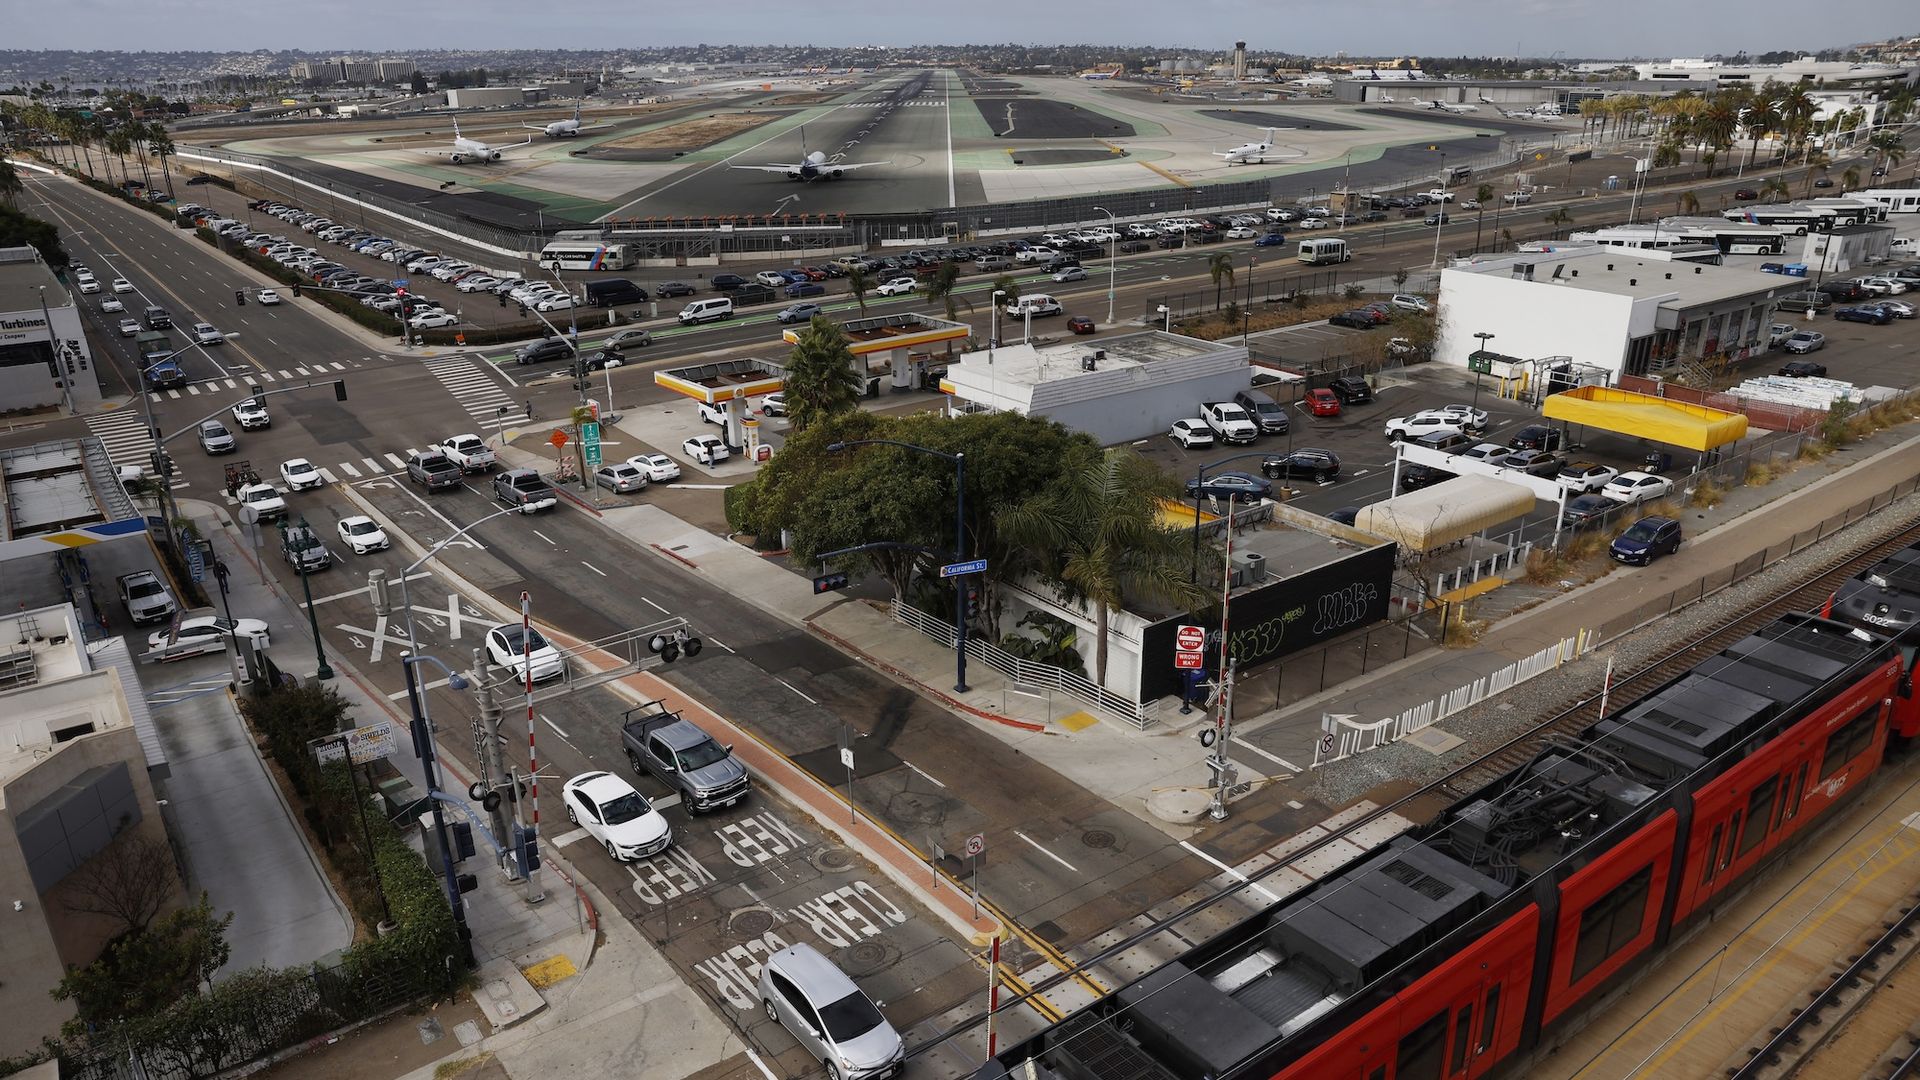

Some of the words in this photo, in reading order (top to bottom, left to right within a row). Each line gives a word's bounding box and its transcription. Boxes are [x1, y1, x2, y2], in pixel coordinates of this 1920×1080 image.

[0, 318, 46, 330] Turbines
[1862, 613, 1889, 627] 5022
[360, 727, 390, 741] SHIELDS
[714, 811, 807, 867] KEEP
[625, 844, 717, 904] KEEP
[788, 880, 907, 948] CLEAR
